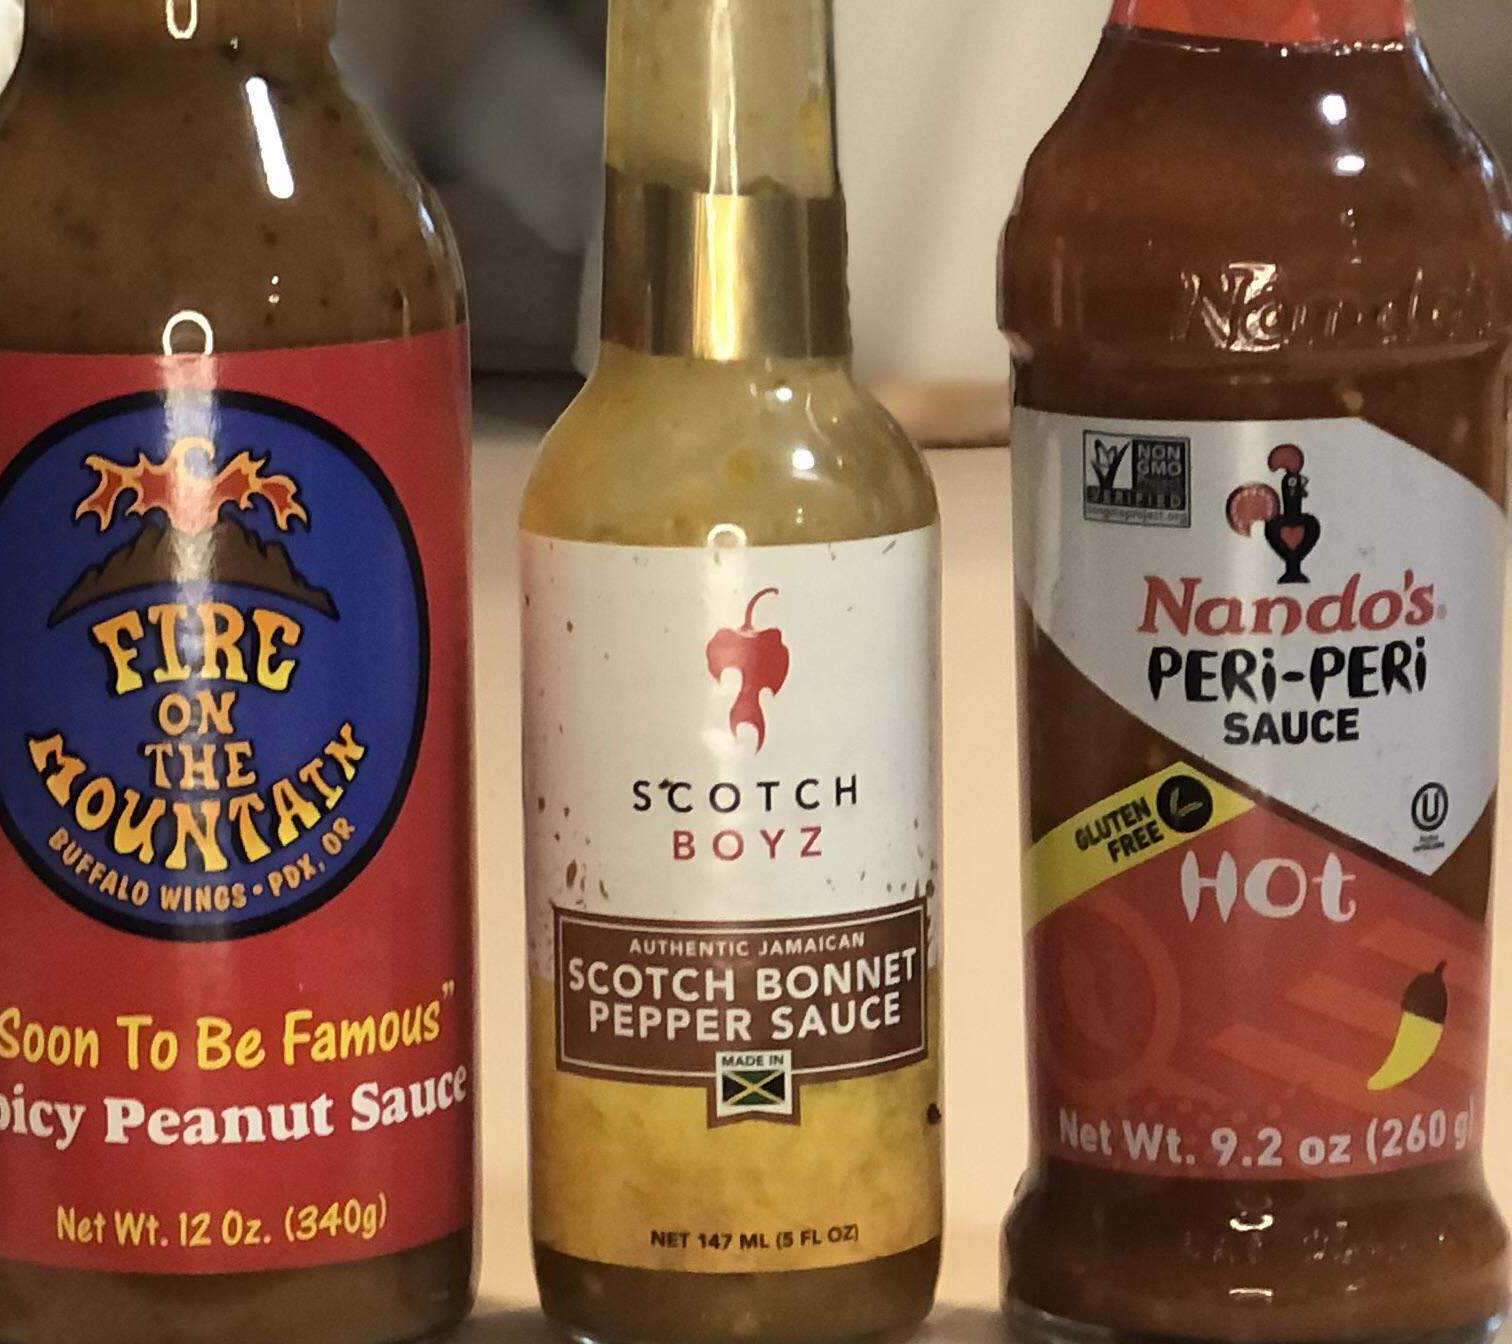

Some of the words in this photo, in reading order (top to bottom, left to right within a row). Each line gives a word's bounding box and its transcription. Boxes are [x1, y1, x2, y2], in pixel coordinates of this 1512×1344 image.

[1136, 459, 1183, 479] GMO
[1137, 444, 1182, 463] NON
[1137, 567, 1435, 637] Nando's
[91, 601, 303, 696] FIRE
[157, 689, 238, 737] ON
[1223, 707, 1360, 747] SAUCE
[144, 739, 257, 791] THE
[28, 722, 366, 873] MOUNTAIN
[631, 773, 859, 815] SCOTCH
[671, 824, 824, 863] BOYZ
[1074, 795, 1151, 853] GLUTEN
[1106, 820, 1165, 864] FREE
[47, 825, 149, 906] BUFFALO
[160, 883, 248, 913] WINGS
[321, 816, 356, 856] OR
[628, 935, 751, 959] AUTHENTIC
[757, 930, 866, 957] JAMAICAN
[567, 956, 735, 1003] SCOTCH
[755, 946, 918, 1002] BONNET
[116, 1013, 179, 1072] To
[195, 1015, 267, 1071] Be
[587, 998, 753, 1043] PEPPER
[770, 990, 903, 1042] SAUCE
[720, 1054, 767, 1068] MADE
[768, 1053, 785, 1067] IN
[103, 1092, 336, 1147] Peanut
[349, 1062, 468, 1133] Sauce
[1058, 1106, 1113, 1153] Net
[1123, 1120, 1196, 1166] Wt.
[1211, 1126, 1284, 1168] 9.2
[1299, 1131, 1352, 1167] oz
[1366, 1108, 1447, 1165] (260
[56, 1204, 105, 1244] Net
[115, 1209, 170, 1248] Wt.
[179, 1211, 212, 1247] 12
[221, 1208, 272, 1247] Oz.
[284, 1191, 388, 1244] (340g)
[650, 1228, 691, 1250] NET
[696, 1231, 733, 1251] 147
[739, 1230, 771, 1251] ML
[775, 1228, 796, 1251] (5
[799, 1226, 823, 1247] FL
[826, 1222, 860, 1244] OZ)
